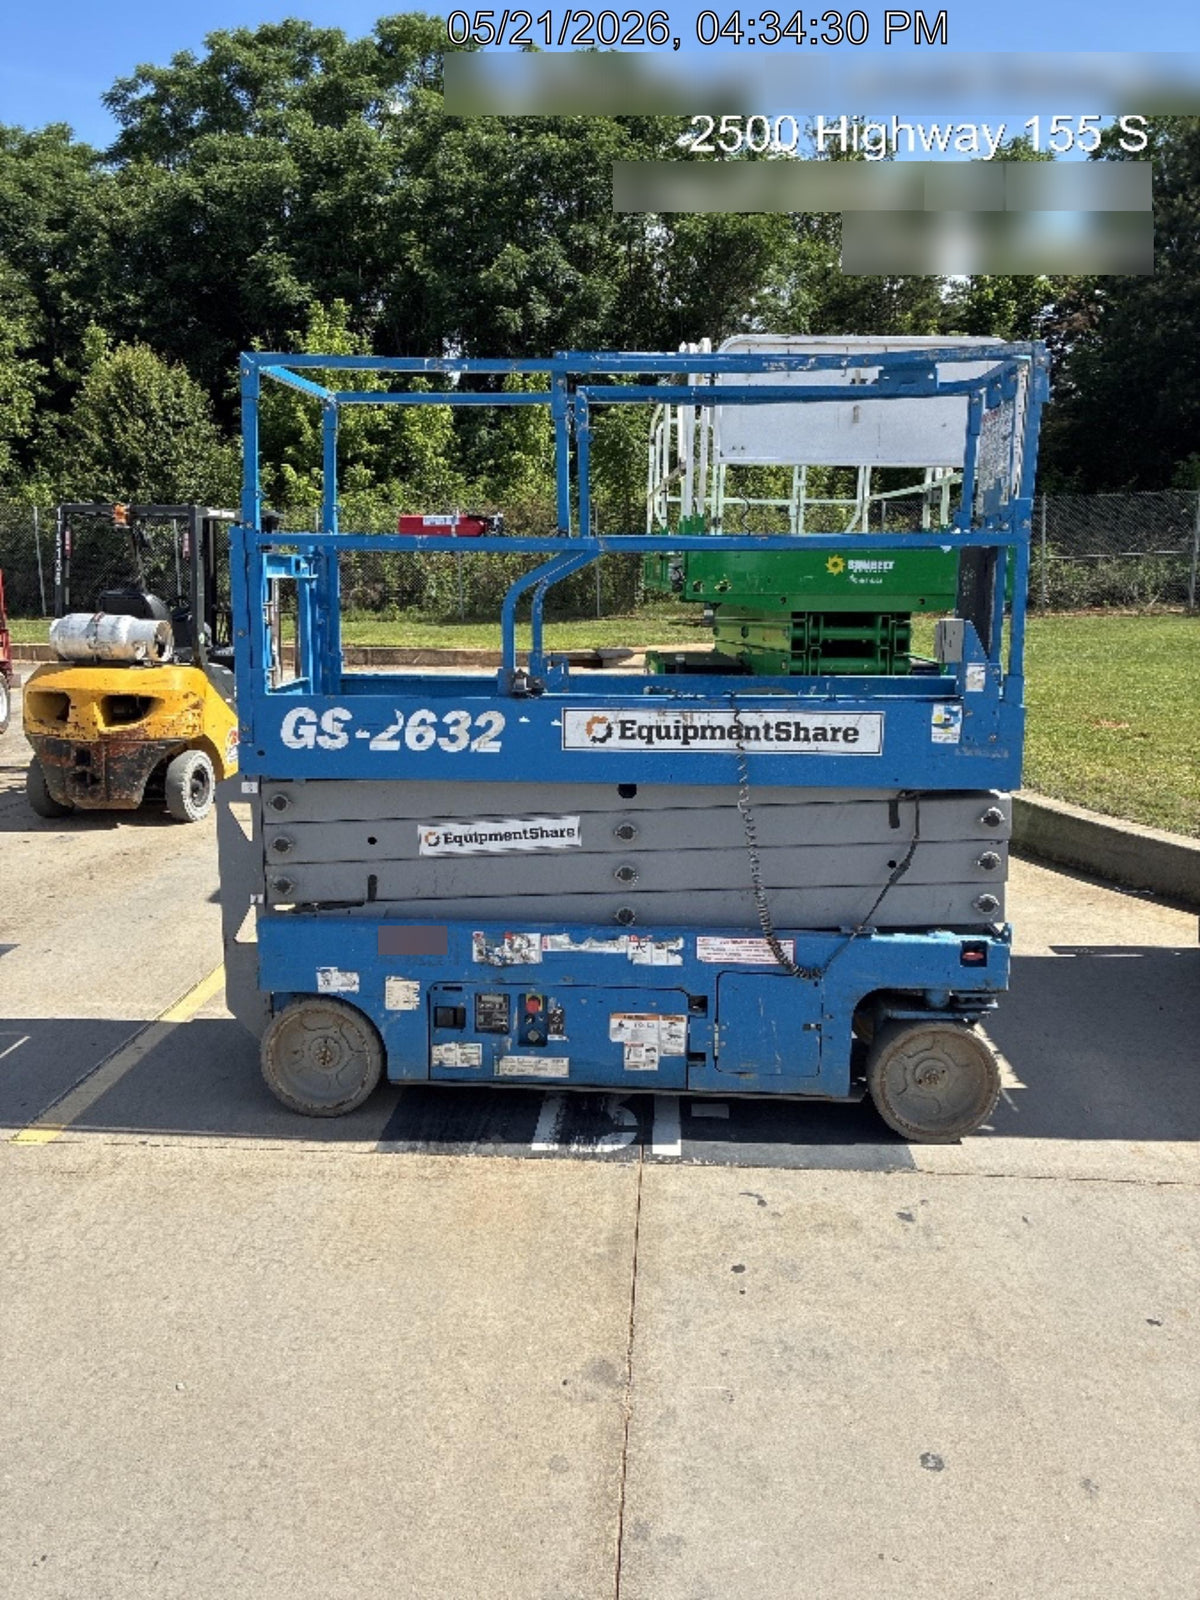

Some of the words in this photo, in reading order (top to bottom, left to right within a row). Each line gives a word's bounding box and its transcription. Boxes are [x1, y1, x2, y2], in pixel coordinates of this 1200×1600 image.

[280, 706, 506, 752] GS-2632
[618, 719, 860, 746] EquipmentShare
[443, 826, 575, 847] EquipmentShare
